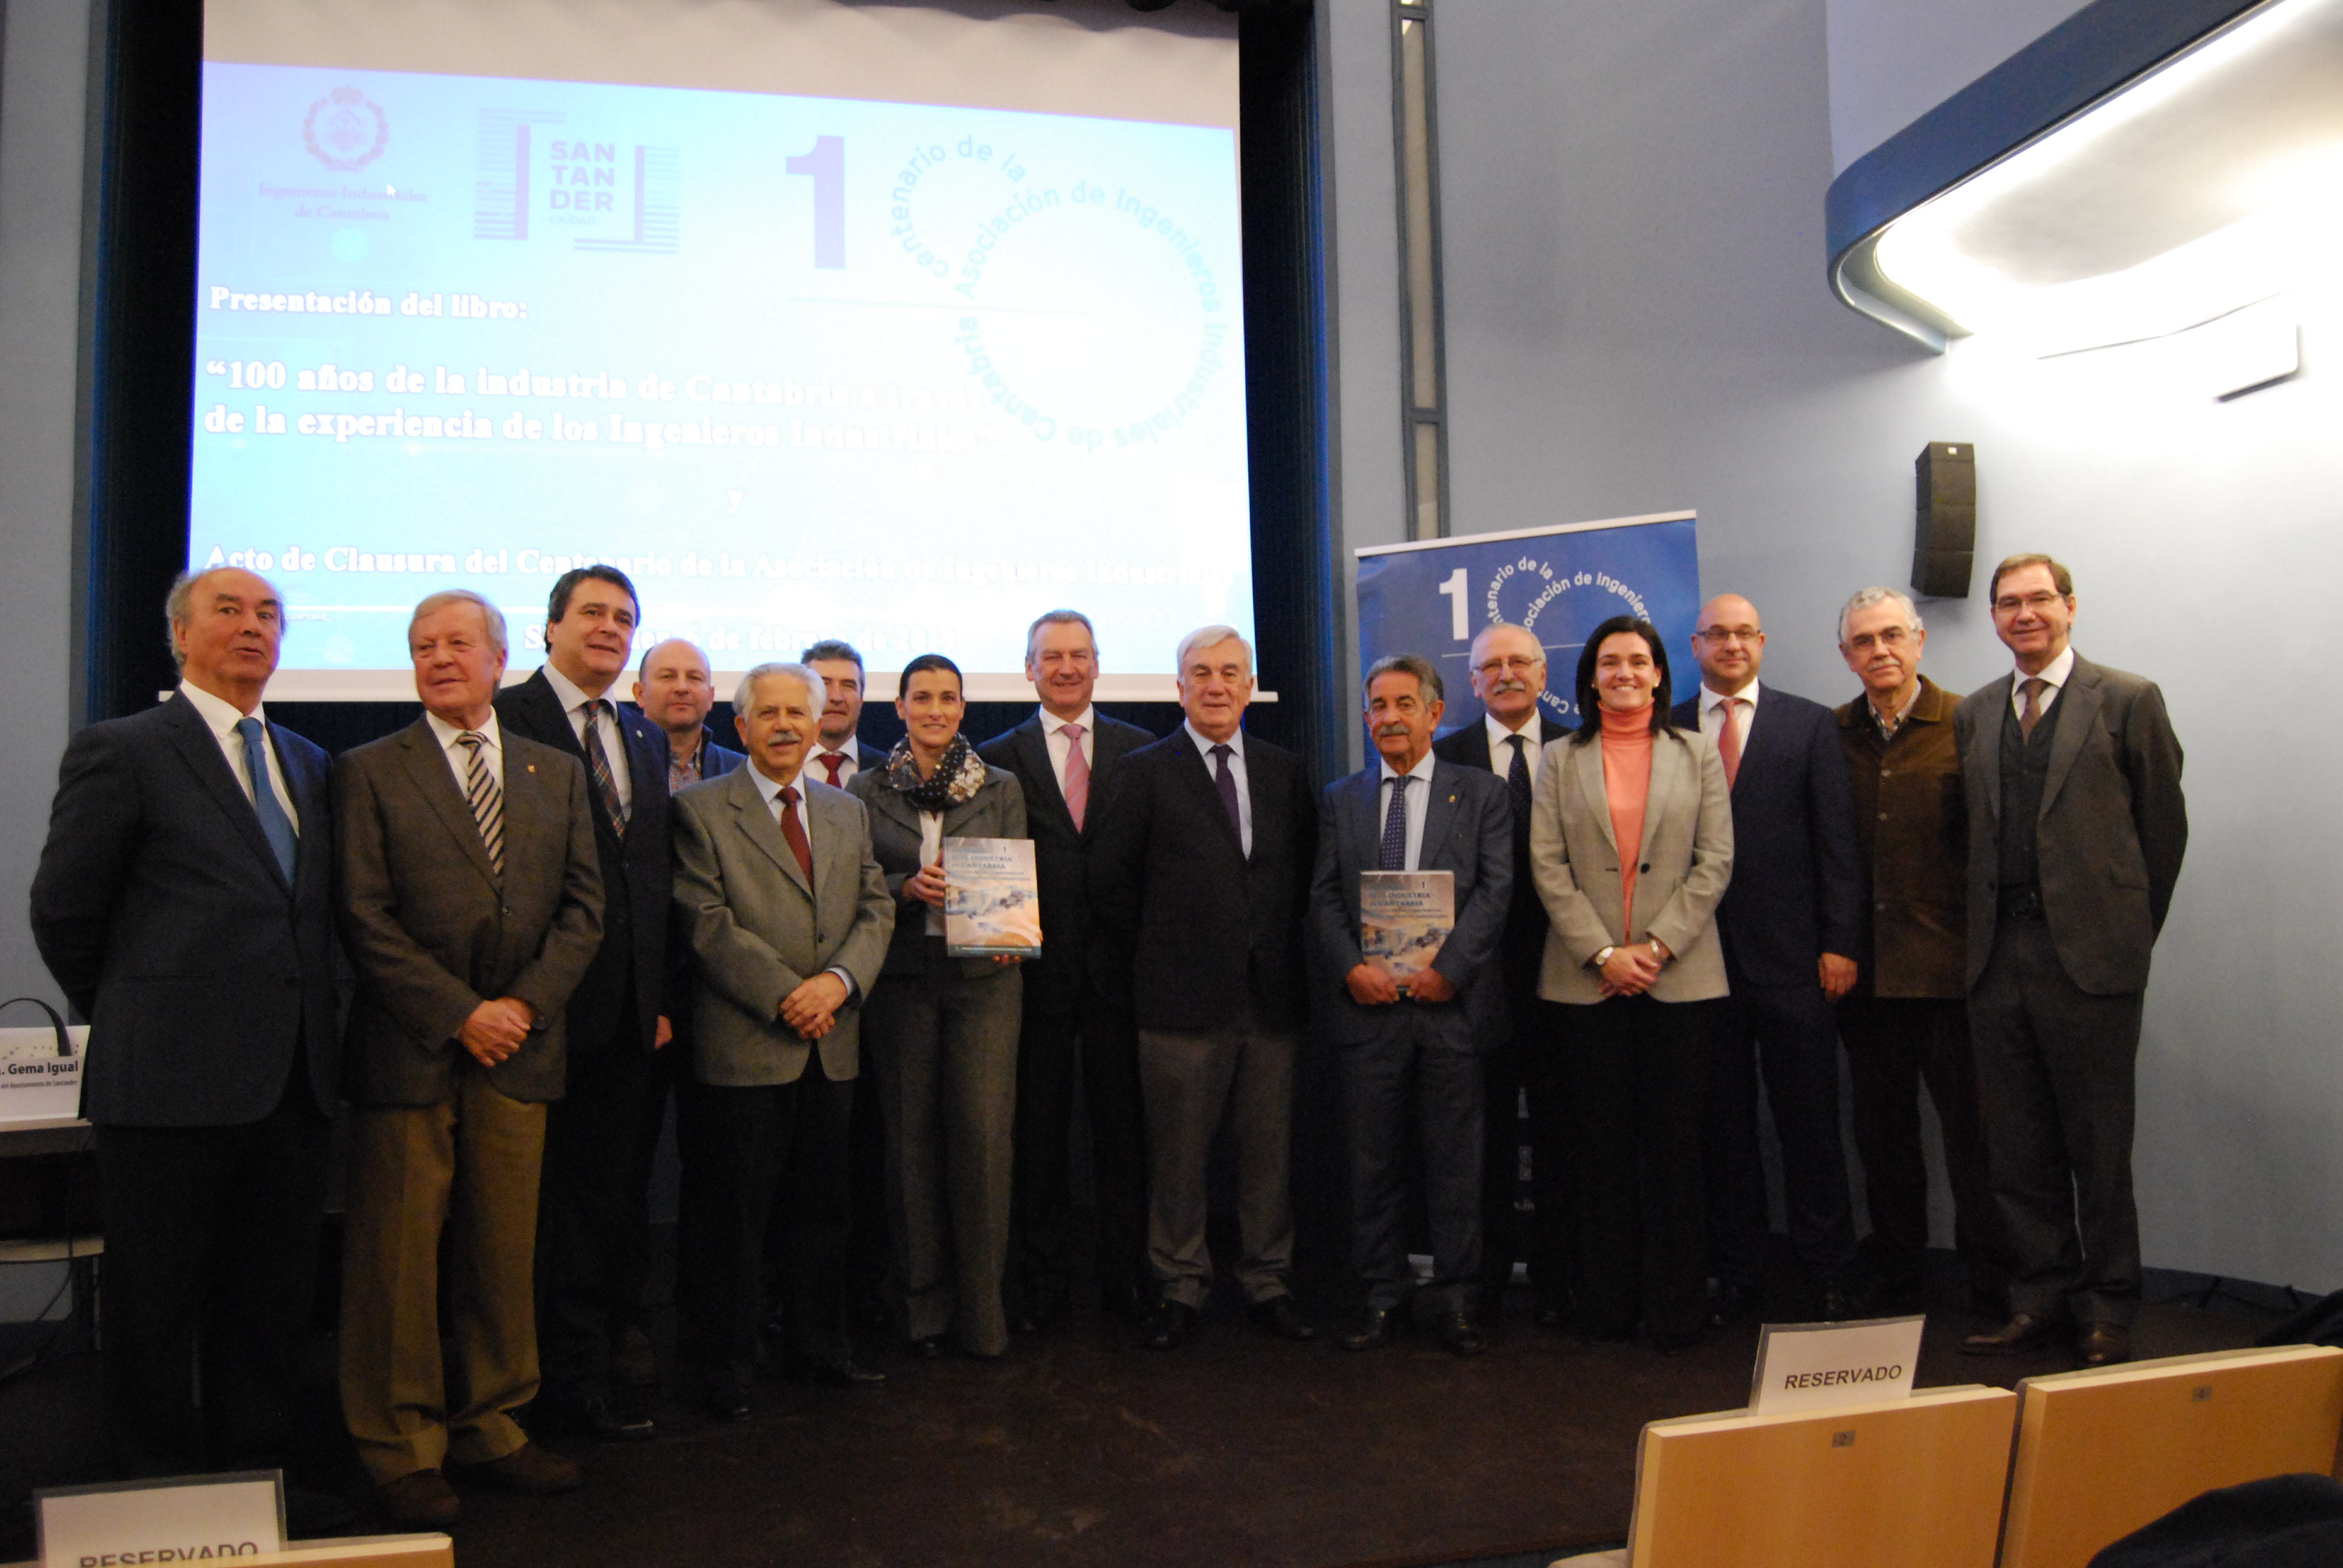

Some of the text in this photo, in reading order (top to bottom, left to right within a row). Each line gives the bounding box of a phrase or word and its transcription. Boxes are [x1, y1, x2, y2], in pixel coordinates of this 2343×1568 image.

[550, 140, 615, 162] SAN
[957, 133, 994, 162] de
[1000, 152, 1027, 183] la
[550, 165, 615, 187] TAN
[259, 182, 336, 201] Ingenieros
[549, 189, 614, 212] DER
[1070, 180, 1107, 205] de
[295, 204, 390, 221] de Cantabria
[951, 187, 1061, 301] Asociación
[1115, 187, 1222, 313] Ingenieros
[209, 286, 528, 320] Presentación del libro:
[296, 364, 375, 393] años
[384, 364, 425, 393] de
[434, 365, 467, 394] la
[477, 367, 628, 399] industria
[638, 372, 677, 400] de
[686, 373, 850, 407] Cantabria
[203, 404, 245, 434] de
[255, 405, 287, 435] la
[297, 408, 493, 443] experiencia
[503, 411, 543, 440] de
[552, 412, 598, 441] los
[608, 414, 779, 450] Ingenieros
[1066, 425, 1104, 456] de
[205, 545, 274, 571] Acto
[280, 546, 316, 572] de
[324, 546, 457, 573] Clausura
[465, 548, 508, 574] del
[680, 552, 712, 577] de
[721, 552, 746, 577] la
[1518, 556, 1537, 571] de
[1539, 561, 1553, 580] la
[1574, 571, 1592, 586] de
[1439, 568, 1469, 640] 1
[708, 625, 741, 651] de
[856, 627, 886, 652] de
[8, 1063, 44, 1074] Gema
[47, 1060, 78, 1076] Igual
[1784, 1365, 1902, 1390] RESERVADO
